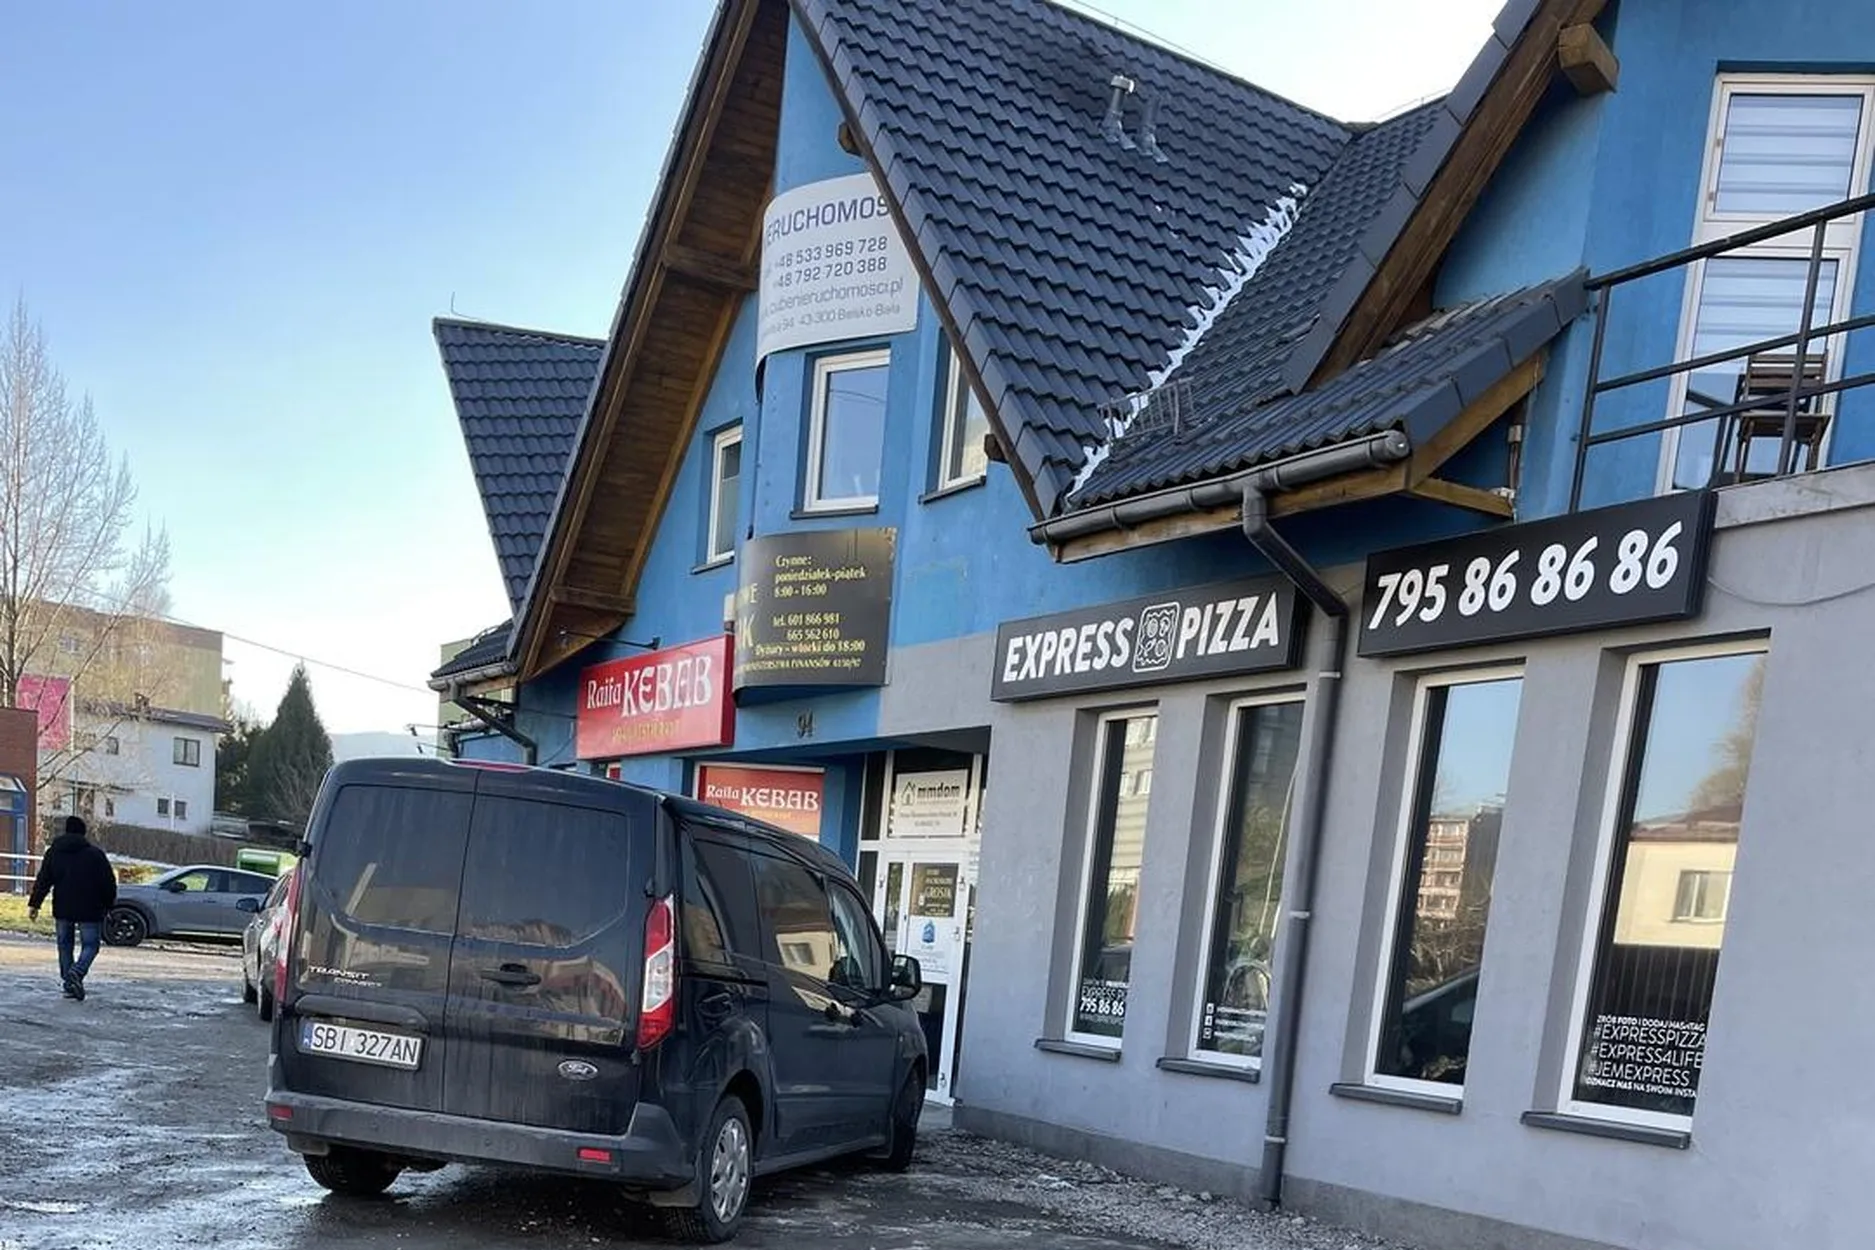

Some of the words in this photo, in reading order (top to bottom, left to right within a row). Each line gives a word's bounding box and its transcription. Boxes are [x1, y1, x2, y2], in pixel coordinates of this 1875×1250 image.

[796, 245, 821, 264] 533
[826, 241, 853, 258] 969
[859, 236, 887, 254] 728
[795, 266, 820, 285] 792
[825, 260, 853, 278] 720
[857, 256, 886, 274] 388
[775, 555, 812, 568] Czynne:
[1368, 563, 1450, 630] 795
[1457, 549, 1520, 616] 86
[1530, 535, 1599, 606] 86
[1609, 520, 1683, 595] 86
[801, 583, 828, 596] 16:00
[822, 627, 840, 639] 610
[1002, 617, 1134, 683] EXPRESS
[1176, 591, 1279, 659] PIZZA
[587, 676, 622, 710] Raifa
[621, 655, 712, 718] KEBAB
[740, 787, 819, 812] KEBAB
[1080, 996, 1097, 1013] 795
[1098, 999, 1110, 1014] 86
[1111, 1000, 1124, 1016] 86
[1618, 1016, 1638, 1026] FOTO
[313, 1025, 347, 1052] SBI
[355, 1032, 418, 1063] 327AN
[1593, 1023, 1708, 1049] #EXPRESSPIZZA
[1590, 1042, 1705, 1069] #EXPRESS4LIFE
